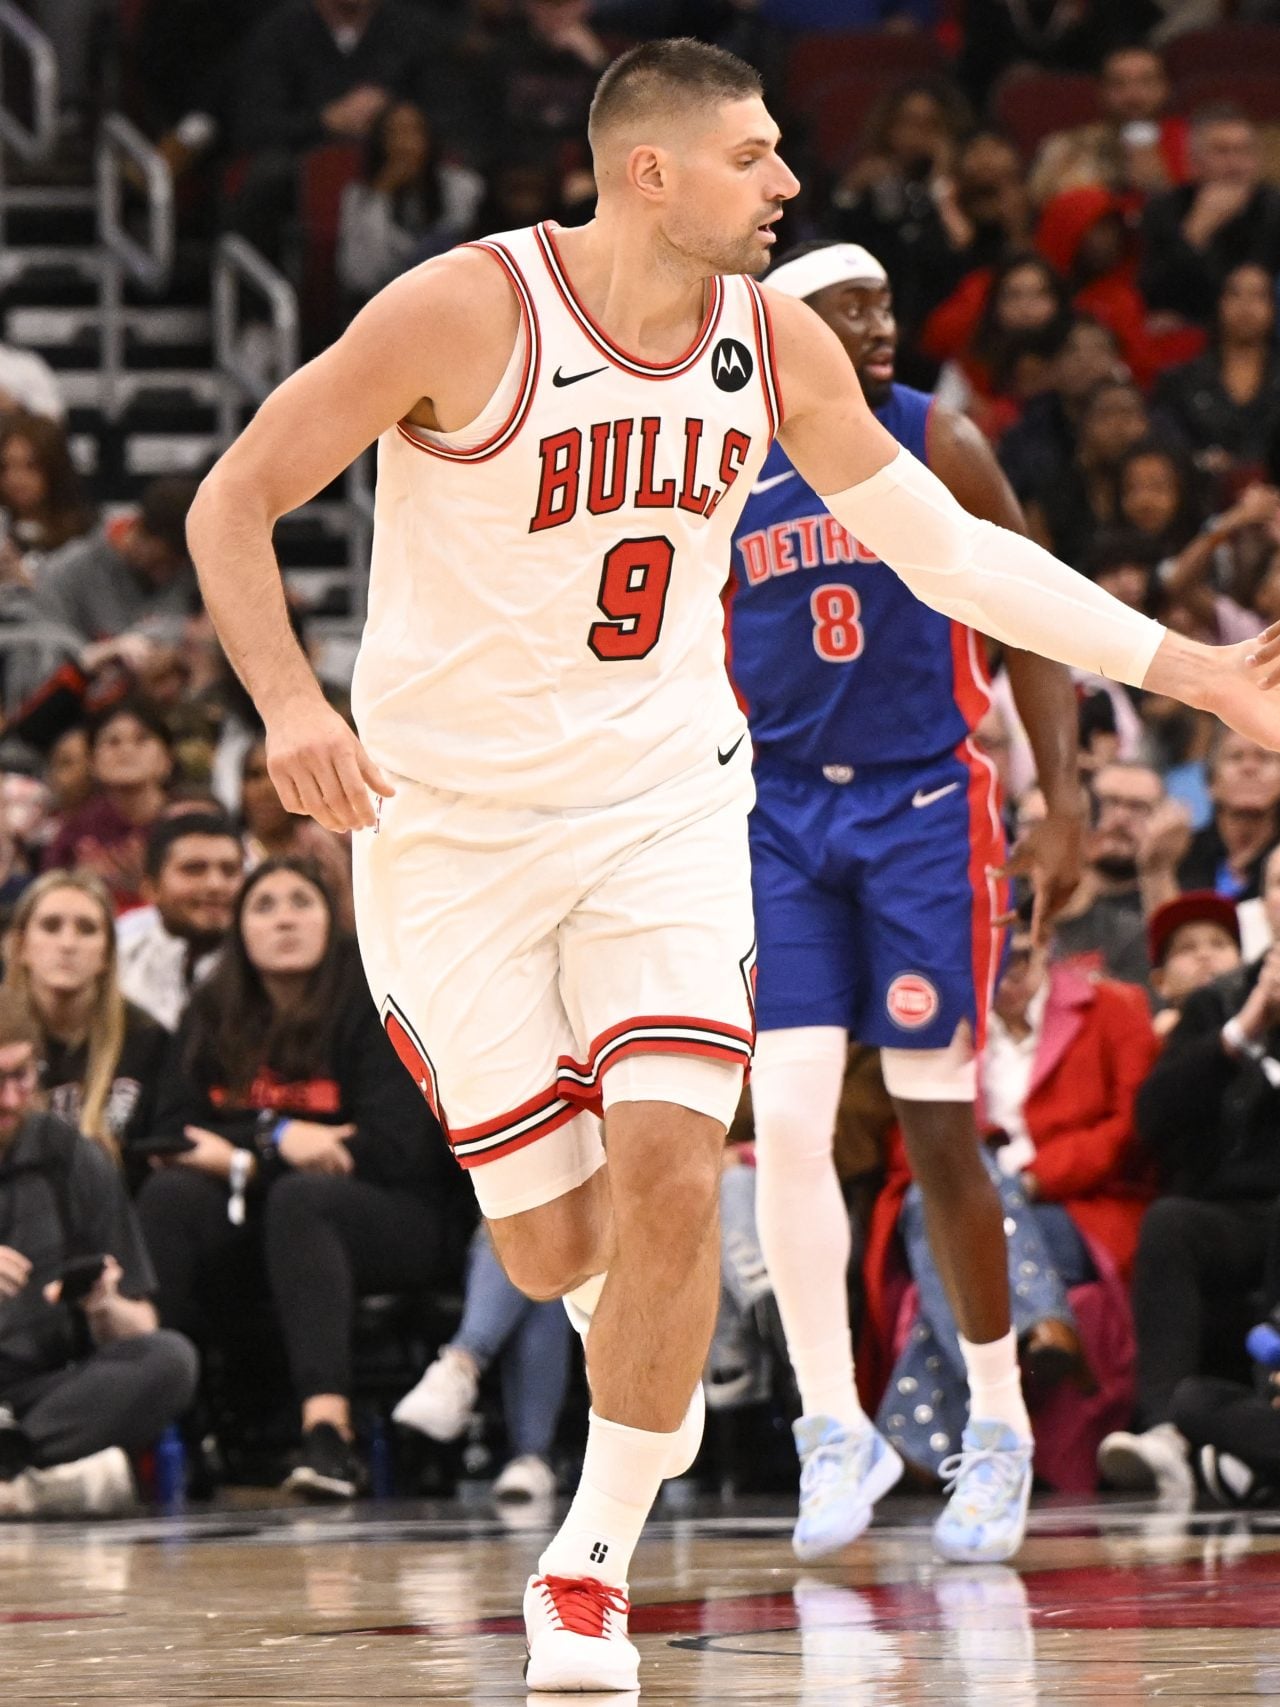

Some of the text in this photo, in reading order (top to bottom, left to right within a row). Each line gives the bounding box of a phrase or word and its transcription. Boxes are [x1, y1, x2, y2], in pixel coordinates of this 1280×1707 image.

[528, 416, 752, 534] BULLS
[587, 535, 675, 662] 9
[810, 583, 865, 663] 8
